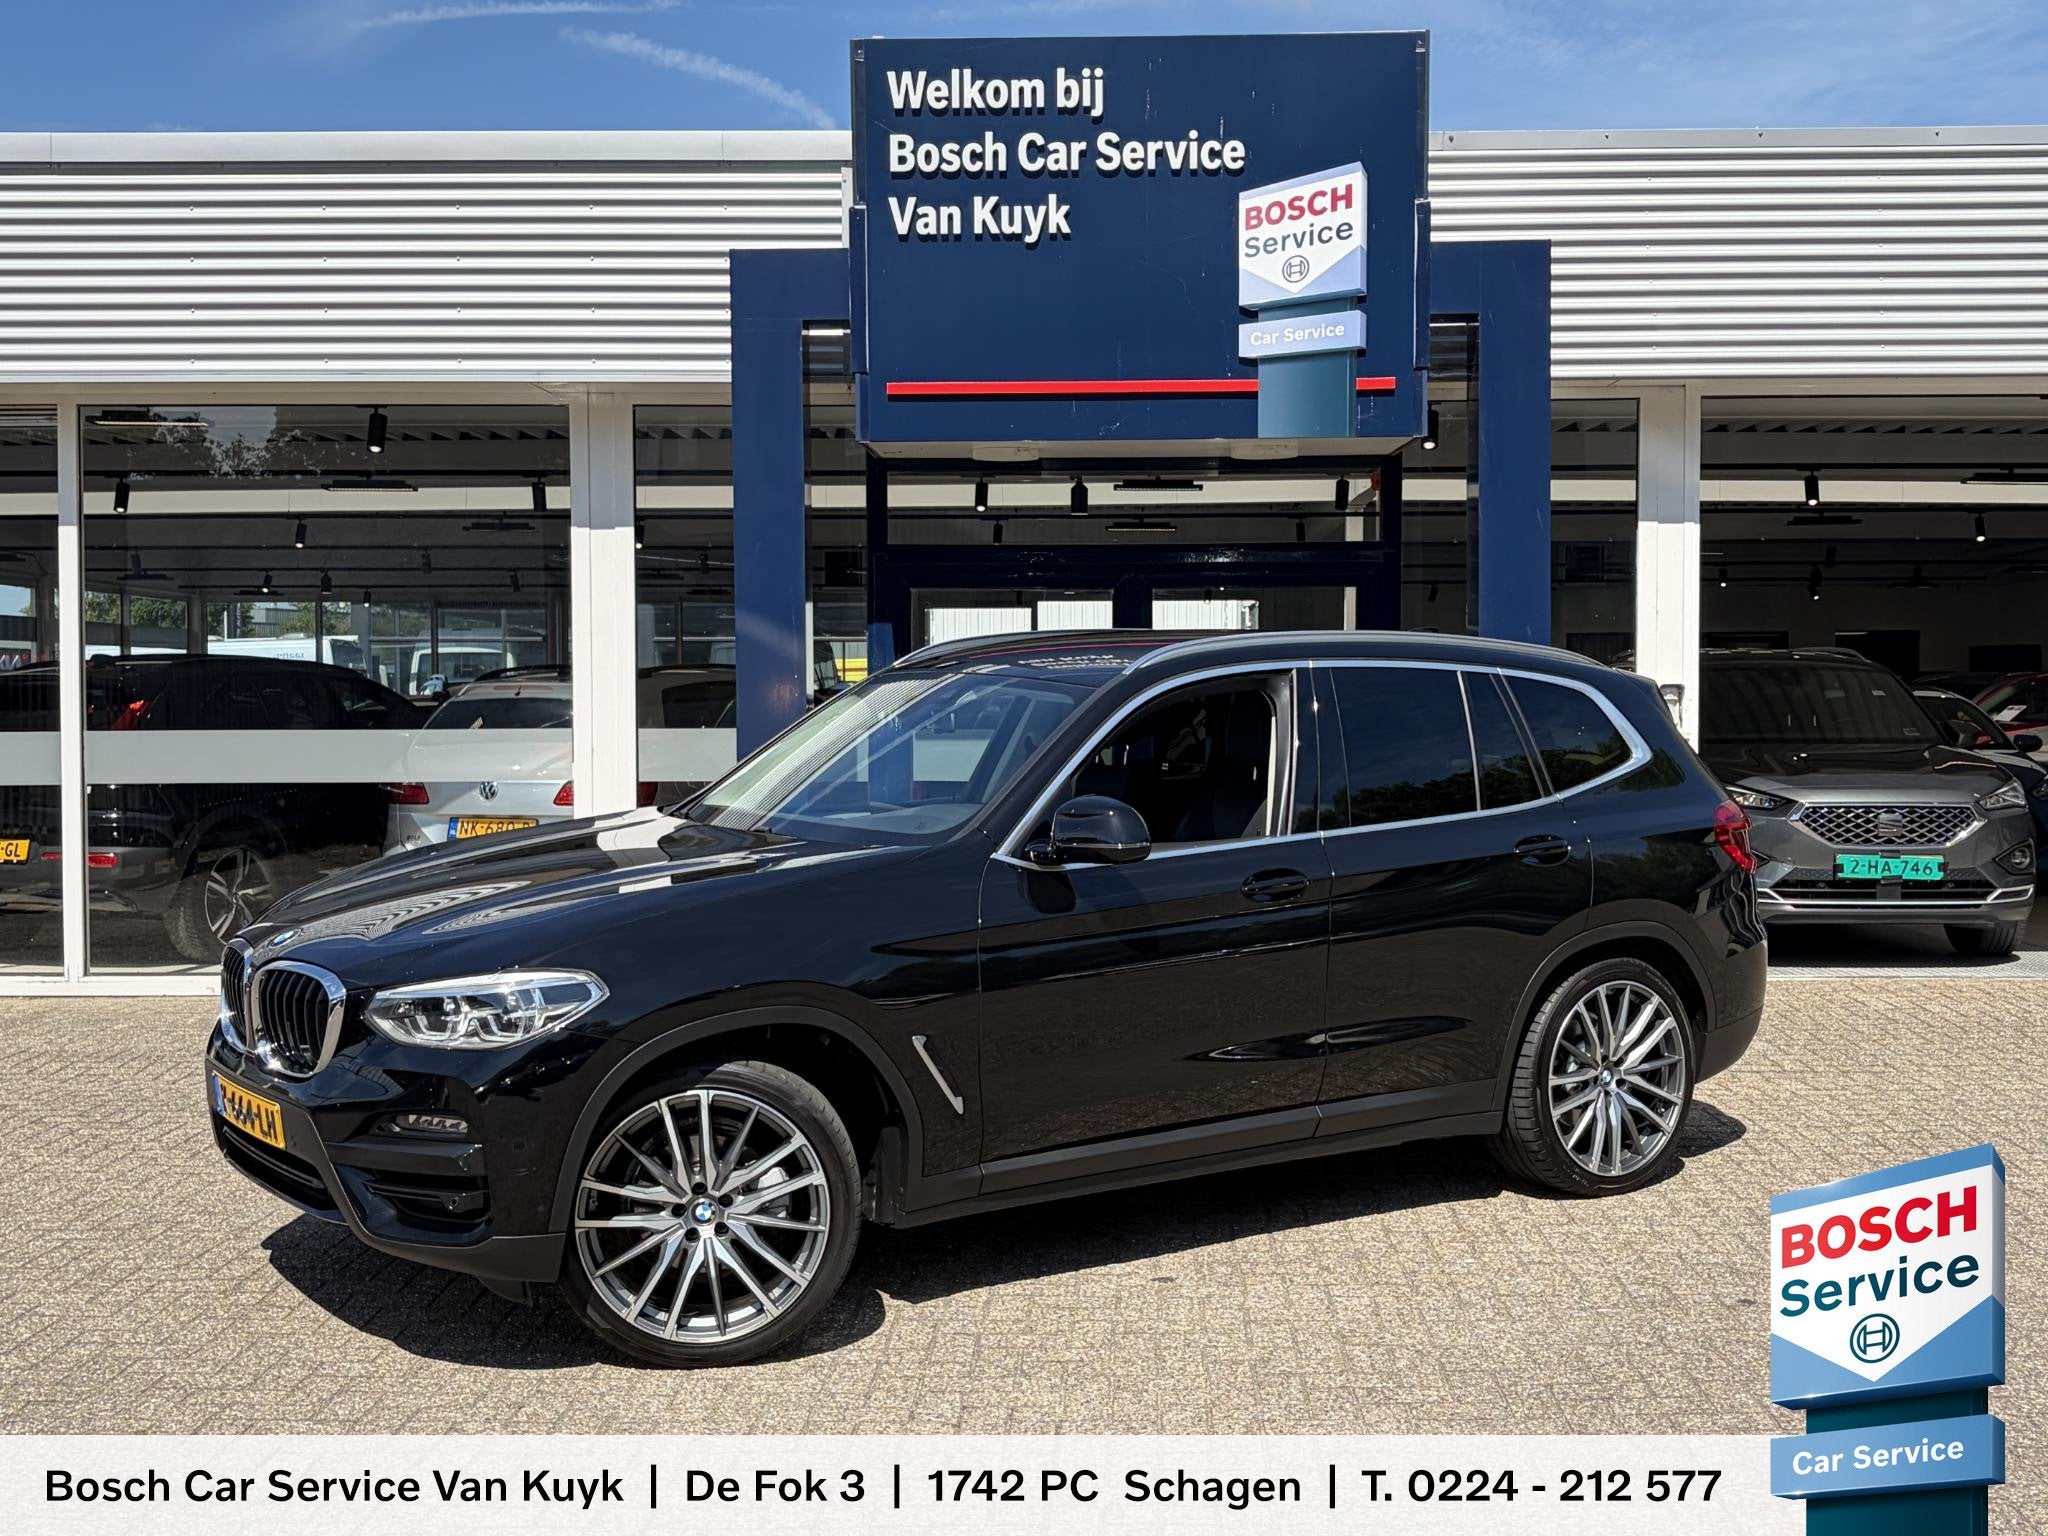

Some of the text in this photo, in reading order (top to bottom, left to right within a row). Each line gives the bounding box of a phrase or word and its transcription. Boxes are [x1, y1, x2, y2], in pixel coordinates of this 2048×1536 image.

[887, 67, 1104, 117] Welkom bij
[889, 130, 1246, 173] Bosch Car Service
[888, 193, 1071, 243] Van Kuyk
[1245, 183, 1353, 231] BOSCH
[1244, 221, 1354, 258] Service
[1250, 323, 1345, 346] Car Service
[1850, 859, 1933, 876] 2-HA-746
